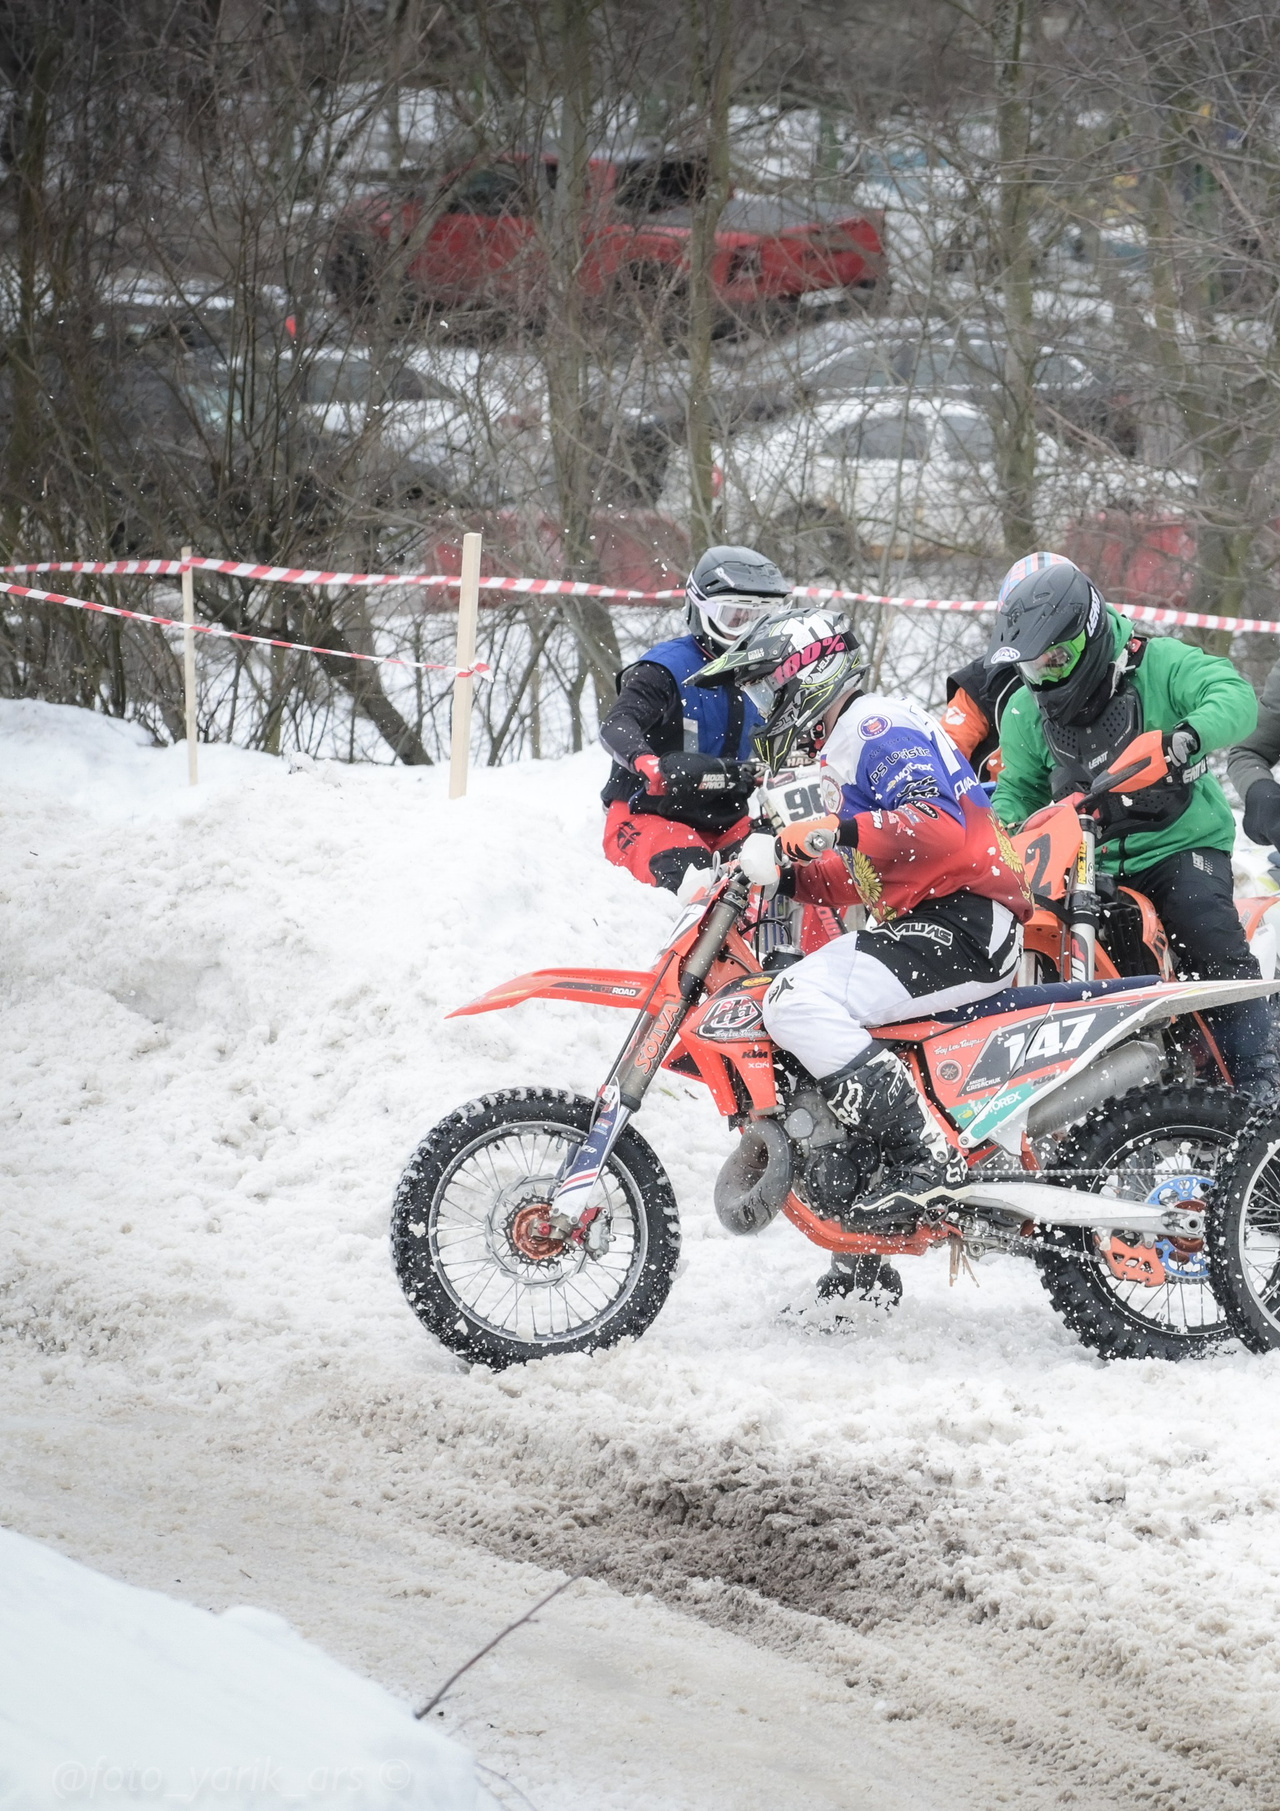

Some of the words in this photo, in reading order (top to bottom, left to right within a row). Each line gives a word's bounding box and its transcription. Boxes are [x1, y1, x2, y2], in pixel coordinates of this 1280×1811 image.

[773, 634, 845, 685] 100%
[870, 762, 888, 784] PS
[612, 987, 637, 996] ROAD
[634, 1004, 680, 1076] SOLVA
[741, 1050, 768, 1058] KTM
[1004, 1013, 1096, 1071] 147
